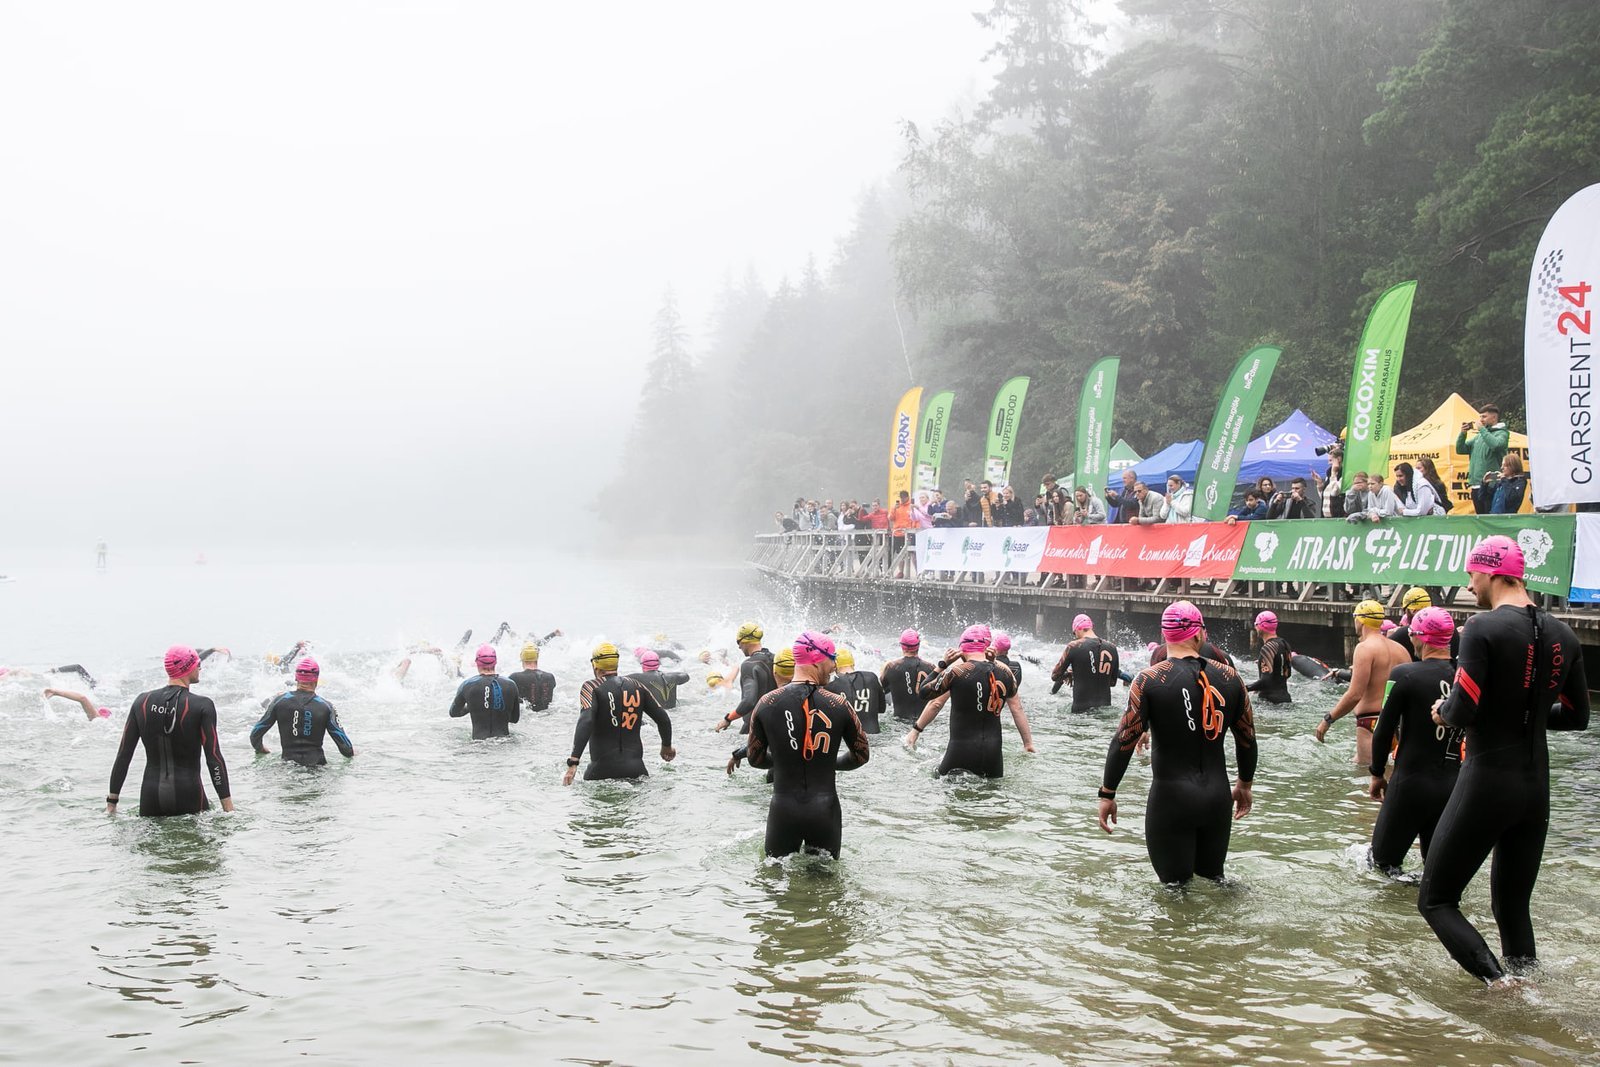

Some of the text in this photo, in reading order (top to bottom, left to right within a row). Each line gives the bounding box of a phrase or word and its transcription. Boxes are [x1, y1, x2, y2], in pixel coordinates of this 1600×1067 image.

[1353, 348, 1380, 441] COCOXIM
[1374, 389, 1386, 442] ORGANIŠKAS
[1382, 349, 1392, 387] PASAULIS
[893, 412, 910, 468] CORNY
[930, 406, 944, 459] SUPERFOOD
[1001, 395, 1017, 452] SUPERFOOD
[1399, 452, 1440, 461] TRIATLONAS
[1286, 535, 1360, 572] ATRASK
[1398, 533, 1484, 573] LIETUV
[904, 671, 913, 695] orca
[1523, 643, 1535, 688] MAVERICK
[303, 710, 312, 737] equip
[608, 691, 618, 728] orca
[784, 710, 798, 751] orca
[1181, 687, 1196, 732] orca
